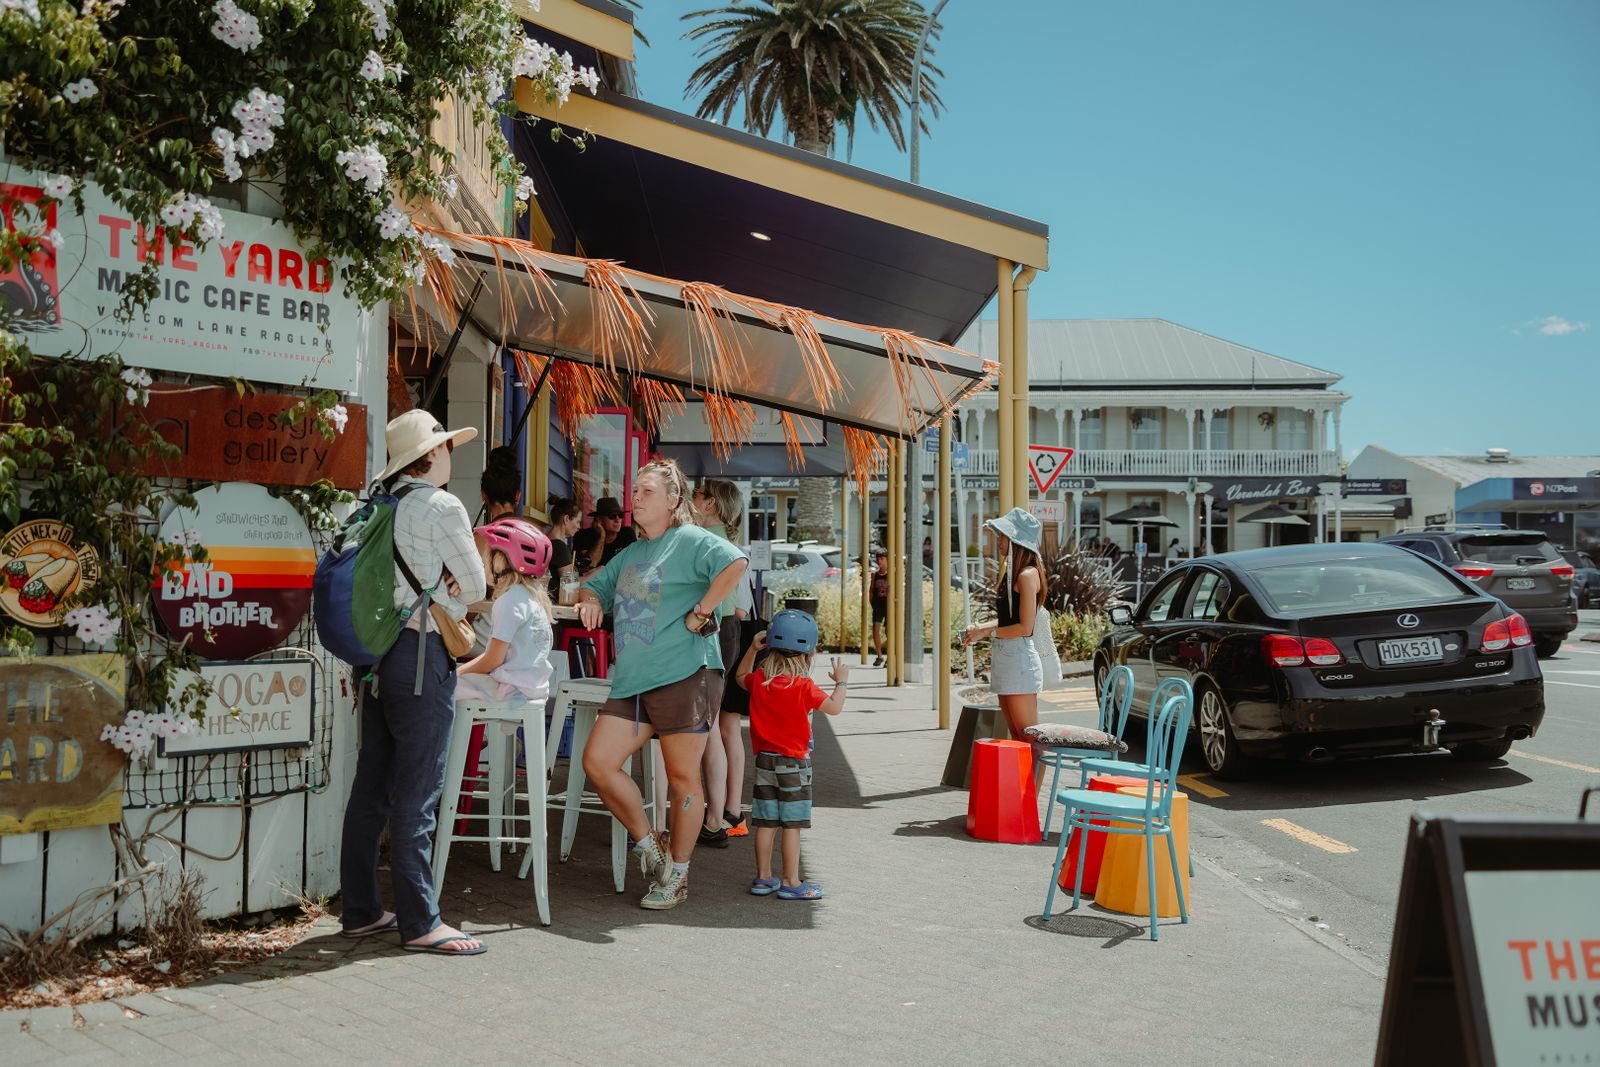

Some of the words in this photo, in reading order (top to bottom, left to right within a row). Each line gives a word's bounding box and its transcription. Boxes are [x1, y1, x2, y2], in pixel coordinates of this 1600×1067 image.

[98, 214, 198, 272] THE
[218, 240, 334, 293] YARD
[98, 267, 190, 304] MIC
[203, 285, 270, 316] CAFE
[283, 297, 331, 325] BAR
[97, 305, 183, 328] VOCOM
[198, 321, 247, 337] LANE
[260, 329, 331, 349] RAGLAN
[223, 437, 328, 471] gallery
[1226, 482, 1282, 501] Verandah
[1285, 479, 1313, 496] Bar
[29, 524, 51, 541] MEX
[215, 512, 270, 526] SANDWICHES
[271, 514, 288, 526] AND
[161, 562, 233, 600] BAD
[179, 601, 278, 629] BROTHER
[1381, 640, 1440, 660] HDK531
[200, 671, 291, 708] OGA
[207, 714, 235, 737] HE
[240, 710, 292, 733] SPACE
[0, 735, 84, 784] ARD
[1507, 939, 1600, 982] THE
